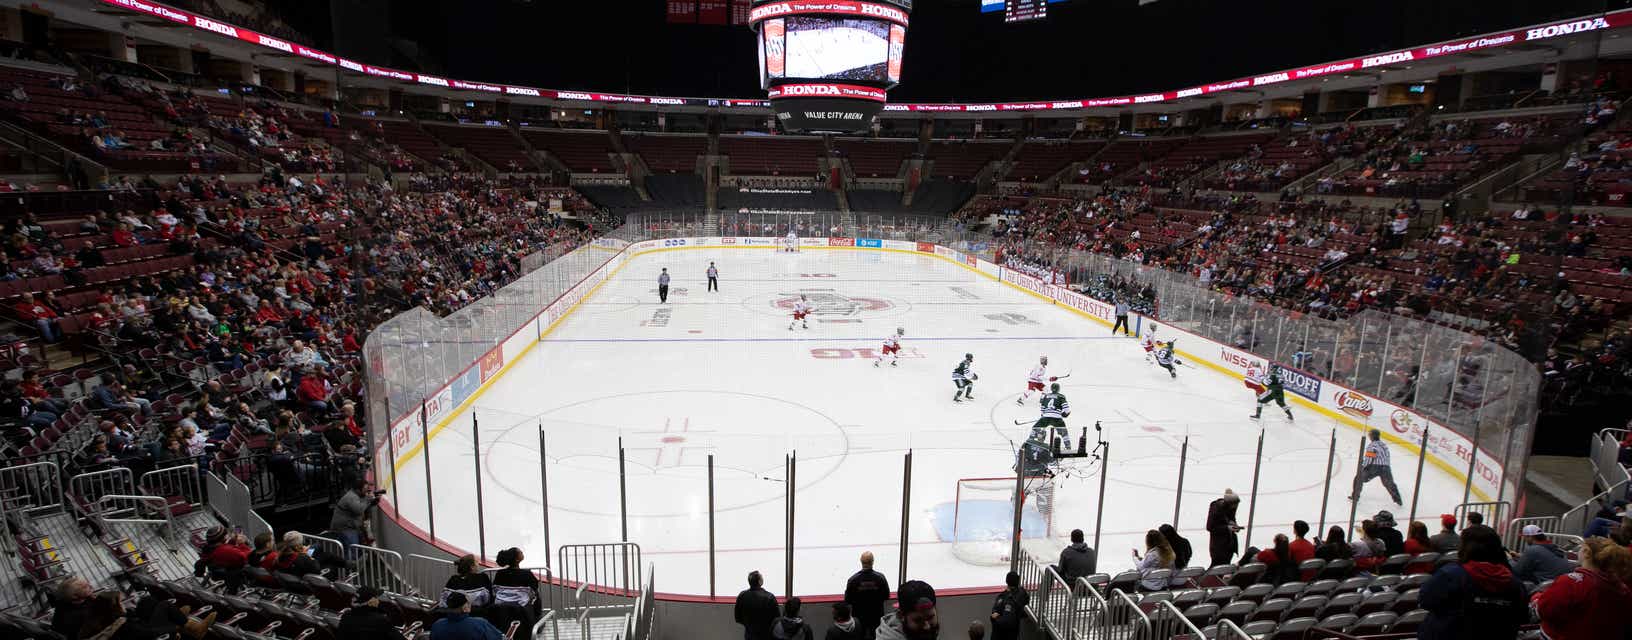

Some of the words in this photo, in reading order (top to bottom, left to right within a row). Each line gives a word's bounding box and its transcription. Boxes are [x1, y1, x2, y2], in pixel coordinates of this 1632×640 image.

[130, 0, 153, 12] Power
[752, 4, 792, 20] HONDA
[861, 4, 904, 20] HONDA
[195, 17, 238, 38] HONDA
[1526, 17, 1610, 40] HONDA
[259, 35, 293, 53] HONDA
[1426, 47, 1441, 56] The
[1442, 42, 1466, 53] Power
[1468, 40, 1478, 50] of
[1479, 34, 1514, 48] Dreams
[340, 58, 364, 72] HONDA
[1362, 50, 1414, 68] HONDA
[1330, 62, 1354, 72] Dreams
[418, 75, 449, 86] HONDA
[1254, 72, 1289, 86] HONDA
[506, 87, 540, 96] HONDA
[558, 92, 592, 100] HONDA
[784, 86, 841, 94] HONDA
[1177, 87, 1202, 98] HONDA
[1134, 94, 1164, 103] HONDA
[1032, 280, 1054, 298] STATE
[1056, 288, 1110, 319] UNIVERSITY
[1282, 368, 1320, 392] RUOFF
[1048, 398, 1056, 409] 4
